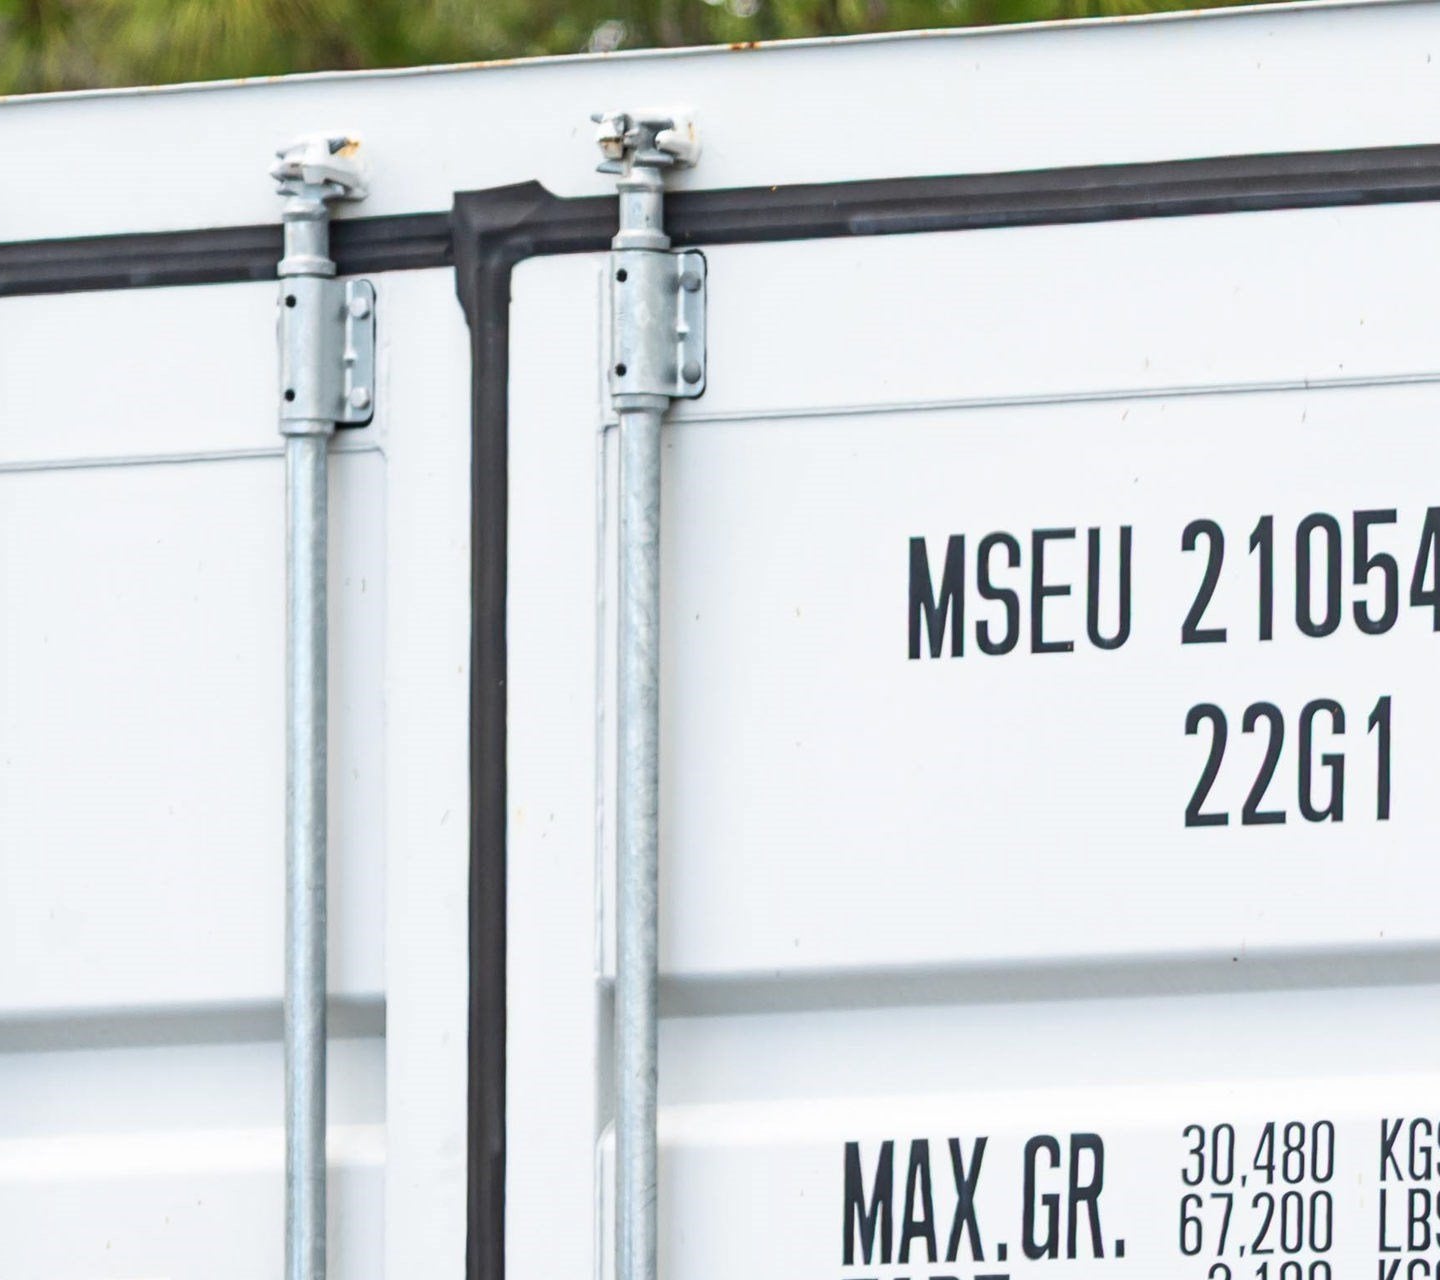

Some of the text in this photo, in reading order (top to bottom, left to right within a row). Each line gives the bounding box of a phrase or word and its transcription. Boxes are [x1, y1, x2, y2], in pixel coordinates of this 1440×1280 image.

[908, 525, 1133, 660] MSEU
[1184, 695, 1392, 828] 22G1
[842, 1133, 1125, 1266] MAX.GR.
[1181, 1120, 1335, 1187] 30,480
[1179, 1190, 1333, 1257] 67,200
